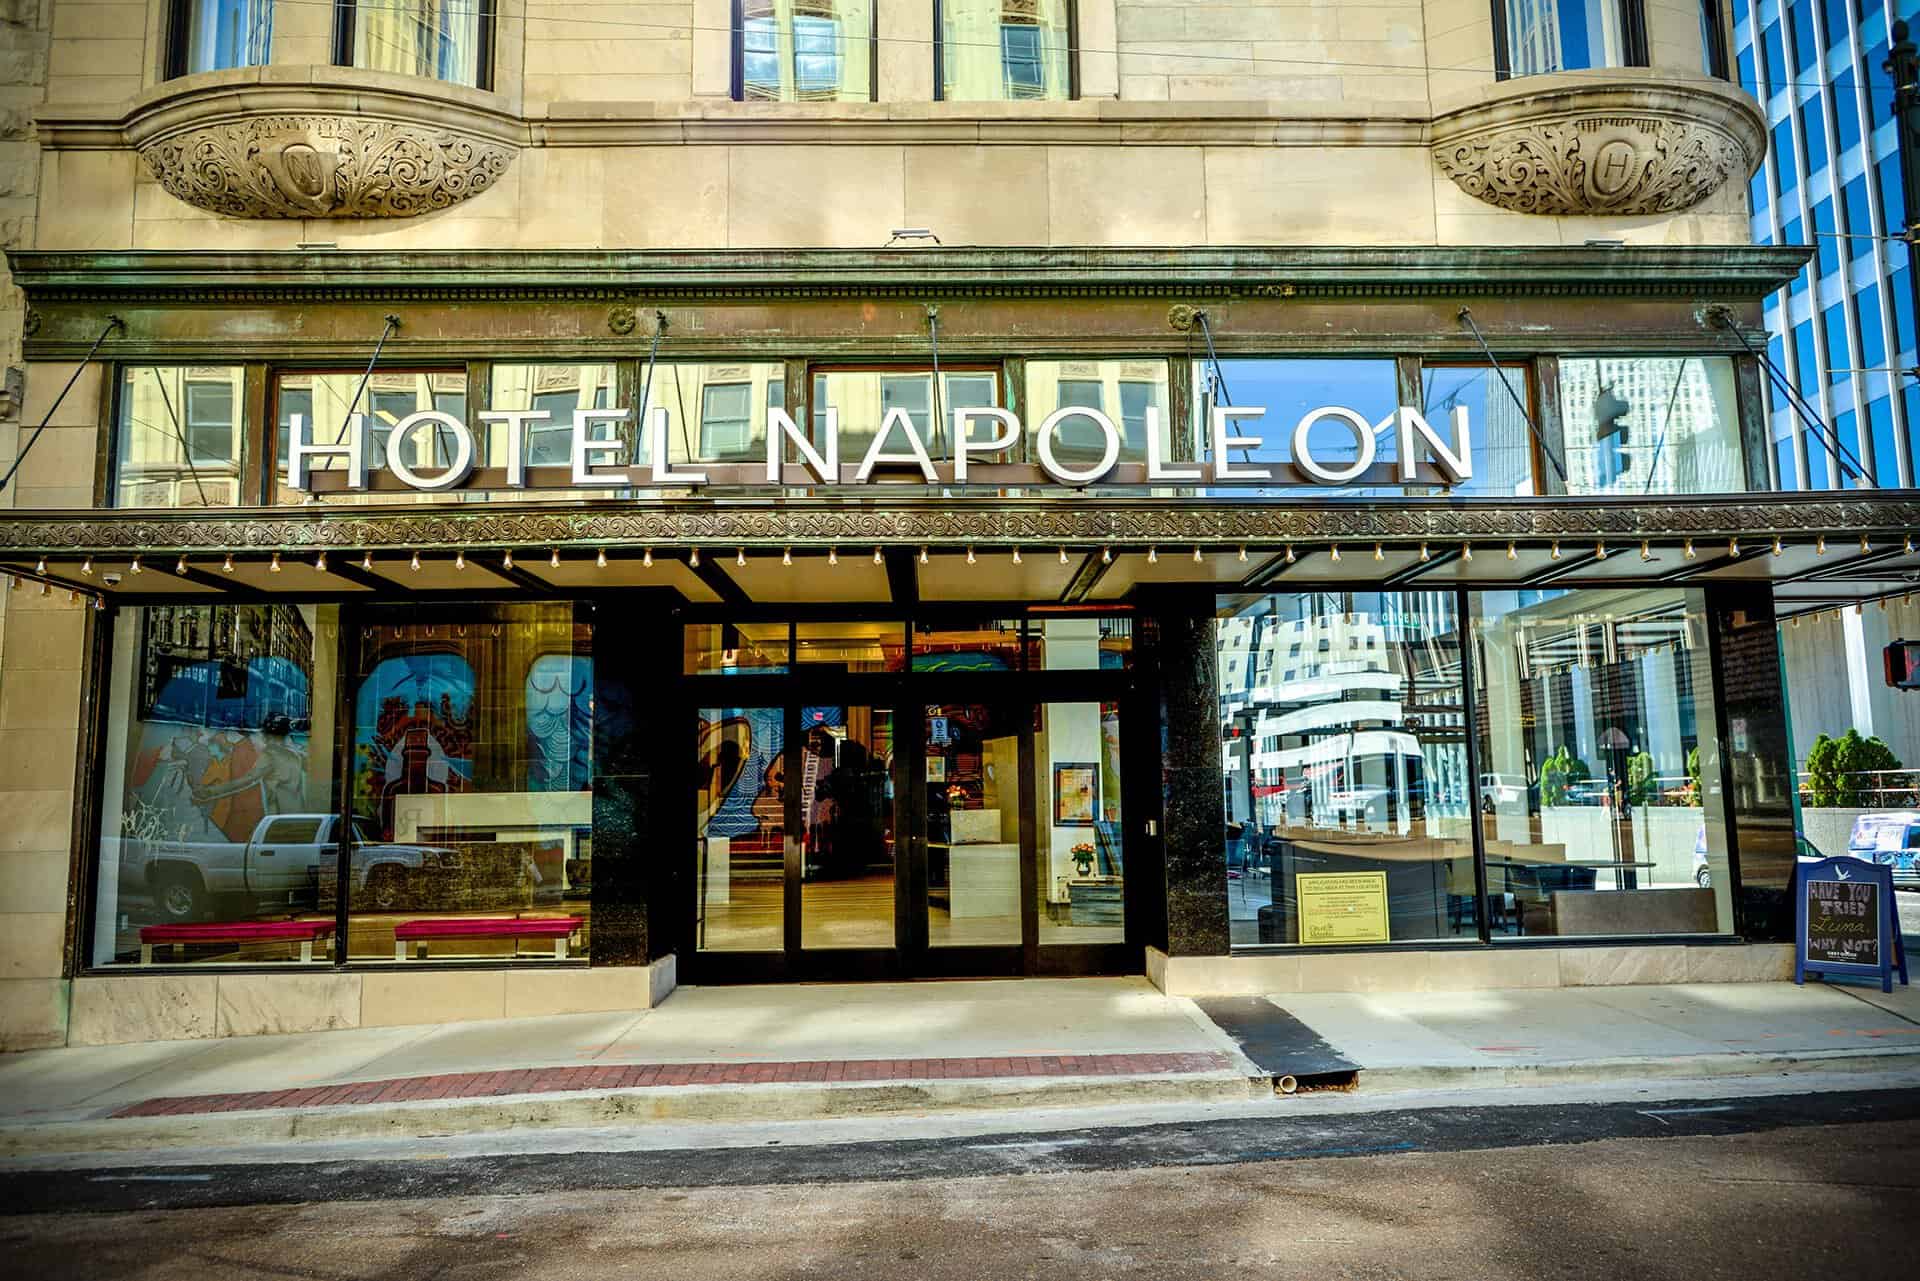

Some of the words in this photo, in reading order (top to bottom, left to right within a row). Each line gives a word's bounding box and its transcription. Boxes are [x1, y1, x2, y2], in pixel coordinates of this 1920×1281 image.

[1604, 153, 1628, 178] H
[288, 407, 707, 491] HOTEL
[766, 404, 1473, 489] NAPOLEON
[1808, 882, 1841, 900] HAVE
[1847, 884, 1872, 902] YOU
[1820, 901, 1867, 917] TRIED
[1808, 937, 1838, 950] WHY
[1842, 938, 1878, 956] NOT?
